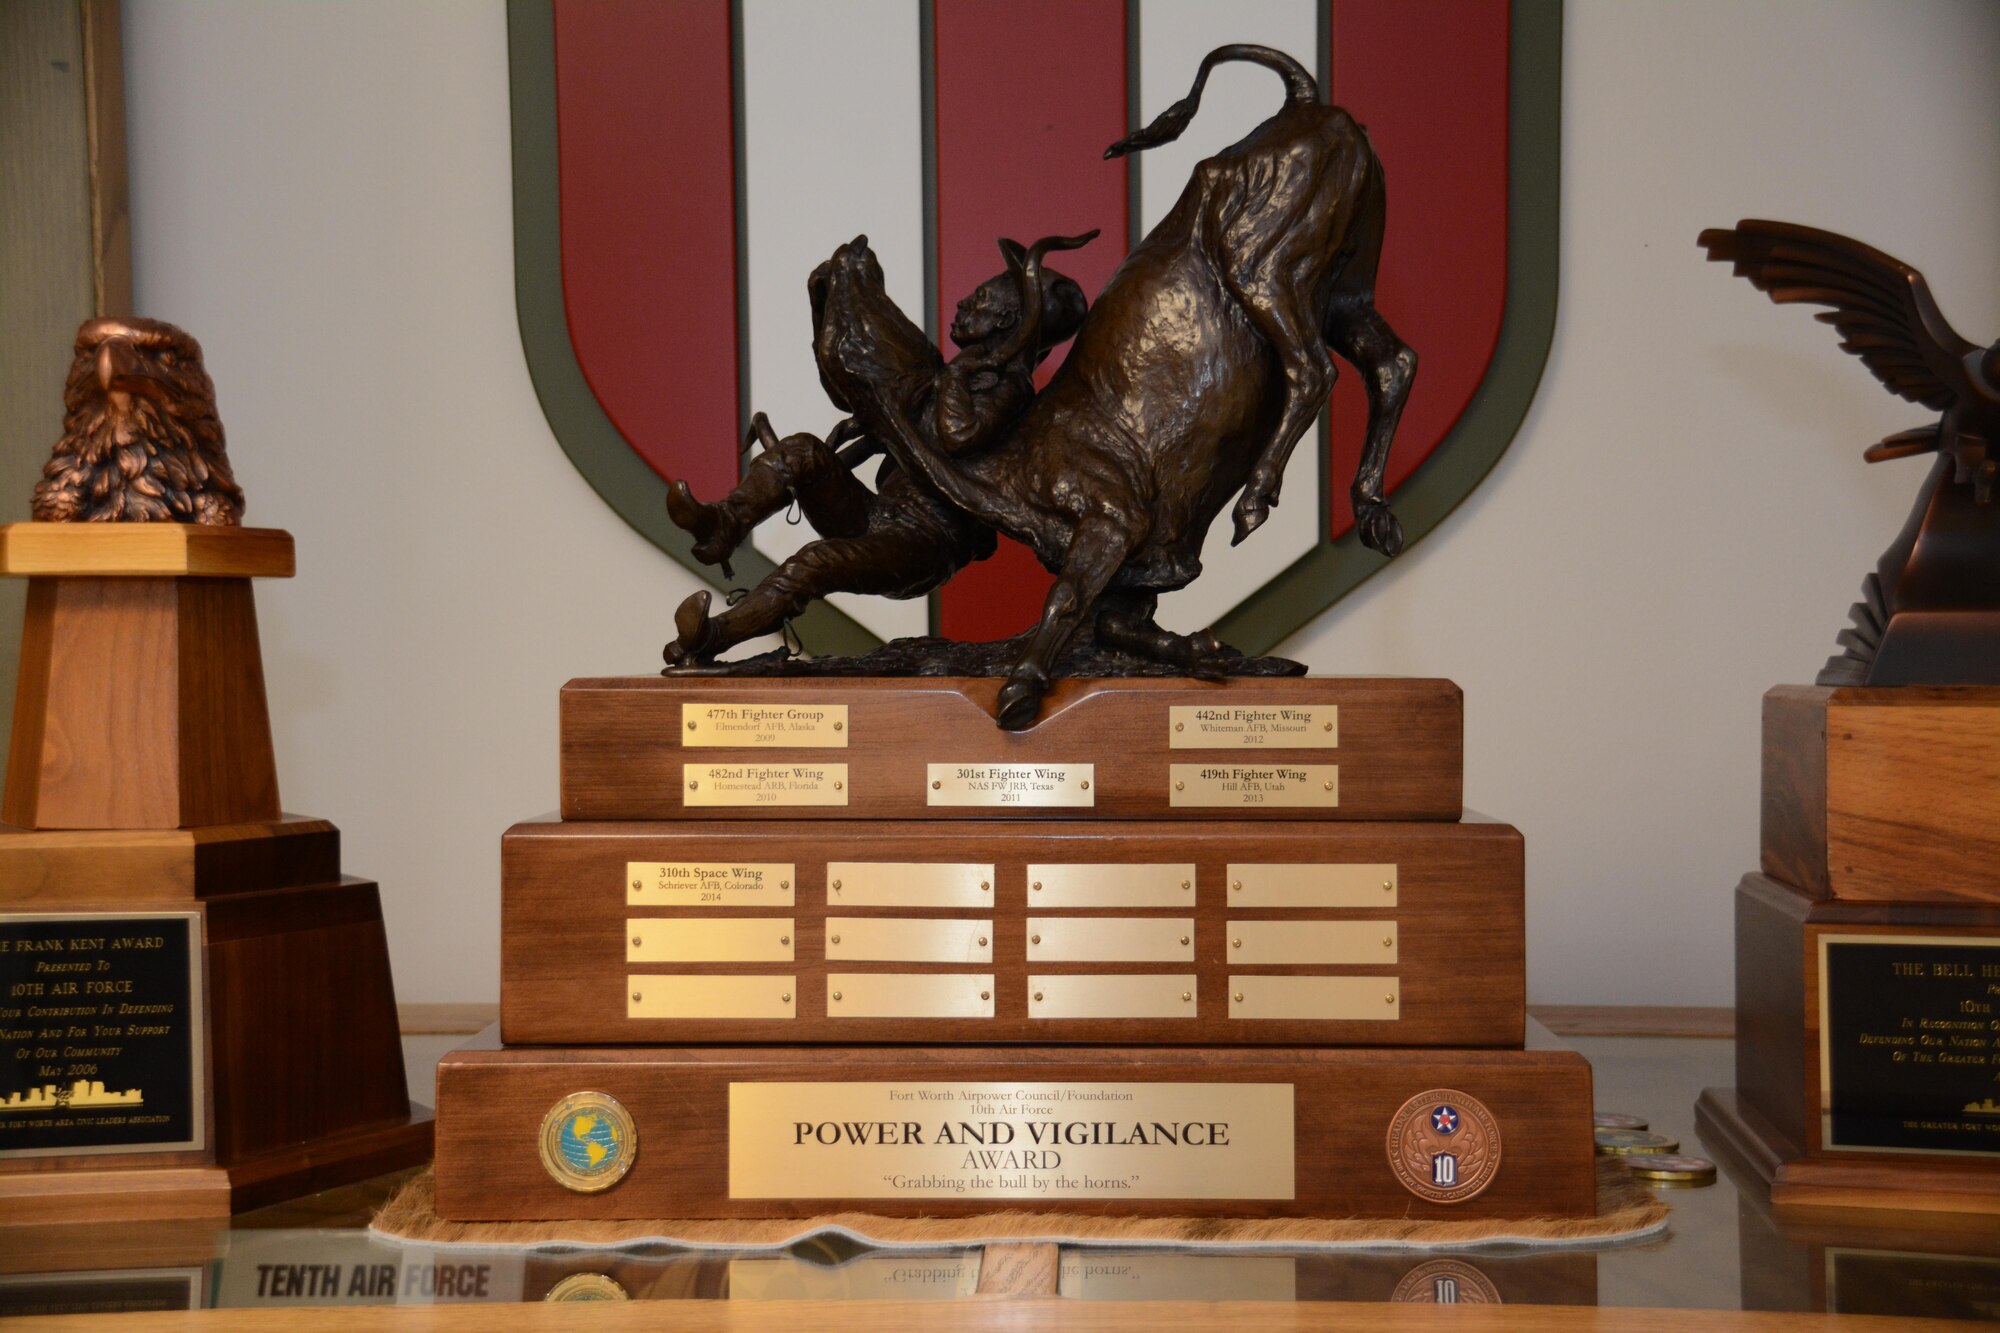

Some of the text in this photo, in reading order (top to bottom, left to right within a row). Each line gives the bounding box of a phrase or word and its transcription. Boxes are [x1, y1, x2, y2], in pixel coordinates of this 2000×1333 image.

[707, 709, 824, 722] 477th Fighter Group
[1195, 710, 1312, 723] 442nd Fighter Wing
[715, 722, 815, 732] Elmendorf AFB, Alaska
[1200, 724, 1307, 733] Whiteman AFB, Missouri
[755, 734, 775, 742] 2009
[1243, 735, 1264, 744] 2012
[708, 768, 824, 781] 482nd Fighter Wing
[956, 769, 1065, 782] 301st Fighter Wing
[1200, 769, 1307, 781] 419th Fighter Wing
[714, 781, 818, 791] Homestead ARB, Florida
[968, 782, 1054, 792] NAS FW JRB, Texas
[1222, 782, 1285, 792] Hill AFB, Utah
[755, 793, 777, 801] 2010
[1001, 793, 1021, 801] 2011
[1243, 794, 1264, 802] 2013
[659, 868, 763, 881] 310th Space Wing
[658, 881, 764, 891] Schriever AFB, Colorado
[701, 892, 721, 901] 2014
[16, 939, 64, 952] FRANK
[70, 938, 105, 951] KENT
[111, 937, 165, 950] AWARD
[1892, 963, 1924, 976] THE
[1933, 963, 1974, 977] BELL
[11, 980, 133, 996] 10TH AIR FORCE
[68, 1064, 98, 1076] 2006
[889, 1089, 1133, 1104] Fort Worth Airpower Council/Foundation
[970, 1104, 1054, 1115] 10th Air Force
[793, 1121, 1230, 1146] POWER AND VIGILANCE
[960, 1150, 1062, 1170] AWARD
[1435, 1155, 1454, 1183] 10
[970, 1175, 994, 1189] the
[999, 1175, 1027, 1189] bull
[1032, 1175, 1050, 1192] by
[1055, 1175, 1079, 1189] the
[257, 1264, 491, 1297] TENTH AIR FORCE
